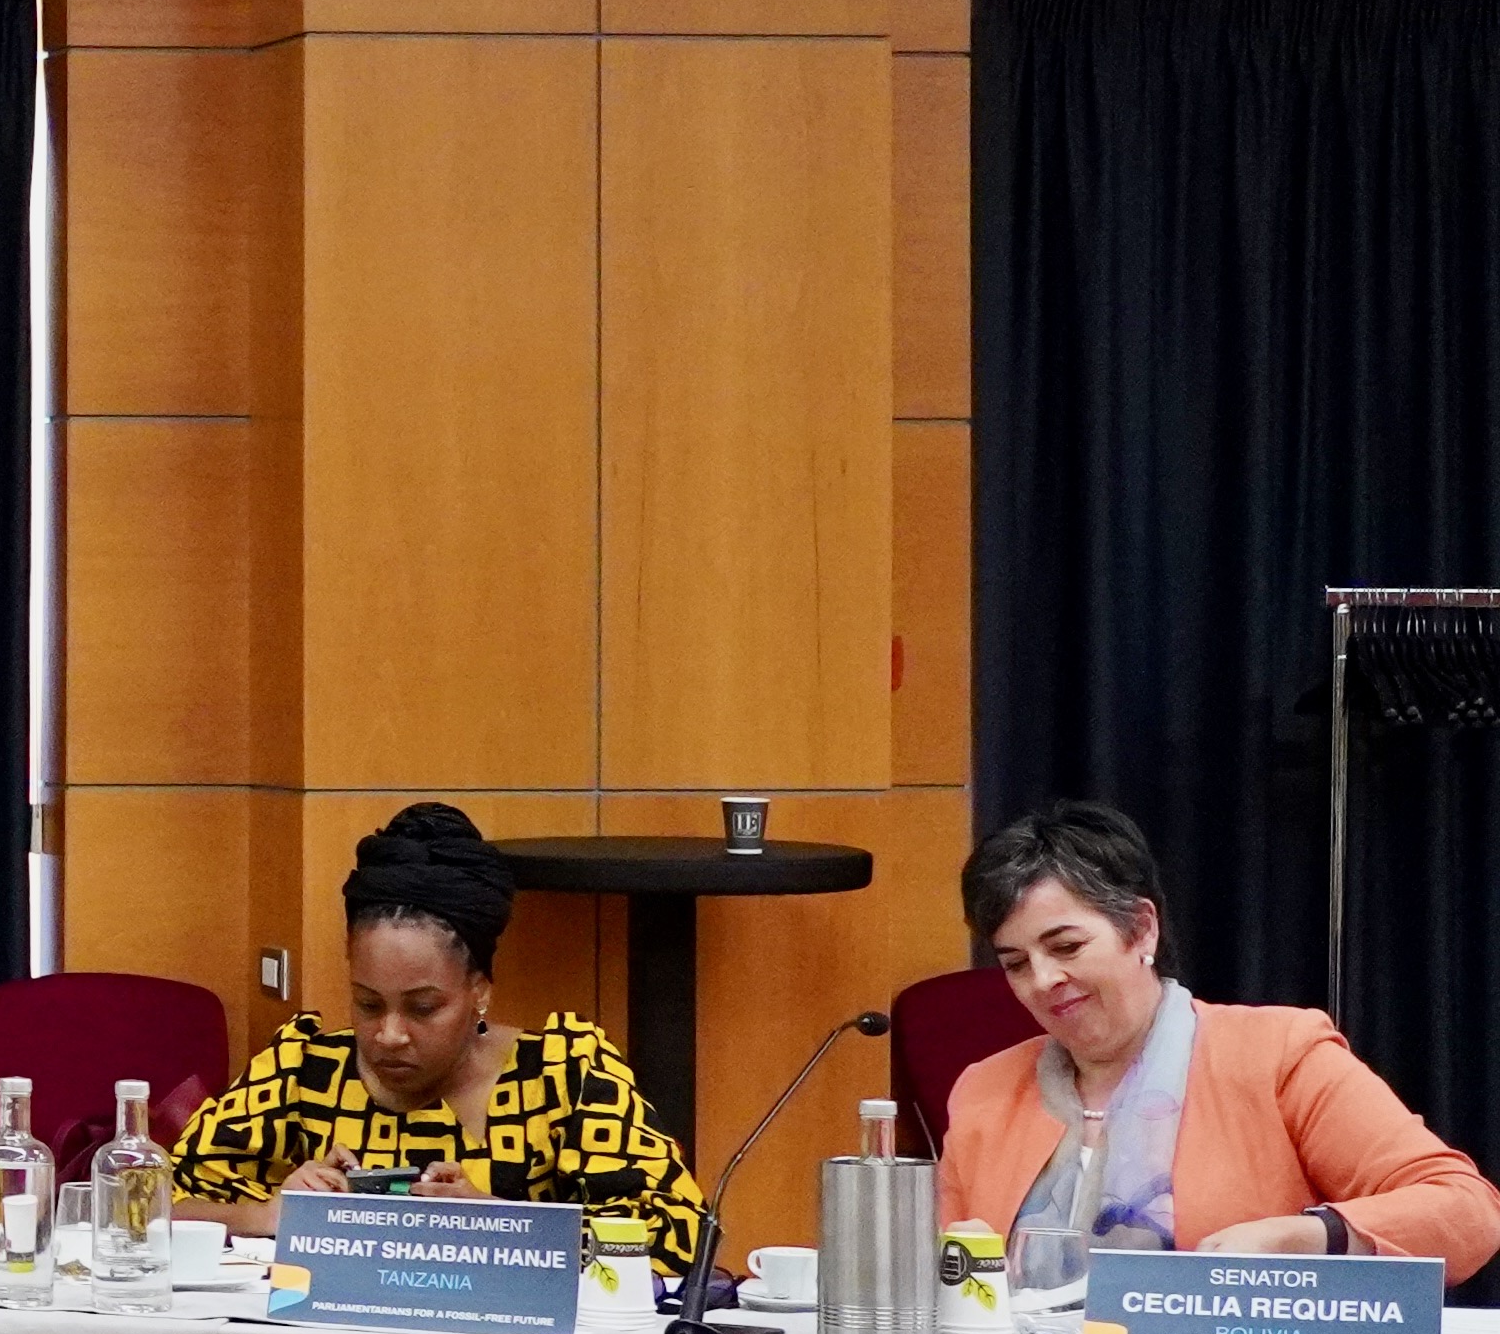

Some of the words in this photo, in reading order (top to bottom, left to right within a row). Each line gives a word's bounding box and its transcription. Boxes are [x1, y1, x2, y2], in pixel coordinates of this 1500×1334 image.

[327, 1209, 398, 1226] MEMBER
[402, 1212, 425, 1228] OF
[429, 1214, 533, 1234] PARLIAMENT
[289, 1235, 377, 1259] NUSRAT
[381, 1240, 488, 1266] SHAABAN
[494, 1247, 568, 1270] HANJE
[377, 1269, 473, 1292] TANZANIA
[1209, 1268, 1318, 1288] SENATOR
[312, 1301, 412, 1316] PARLIAMENTARIANS
[413, 1307, 434, 1318] FOR
[435, 1309, 445, 1319] A
[445, 1310, 512, 1324] FOSSIL-FREE
[513, 1315, 555, 1327] FUTURE
[1121, 1291, 1243, 1318] CECILIA
[1250, 1296, 1404, 1324] REQUENA
